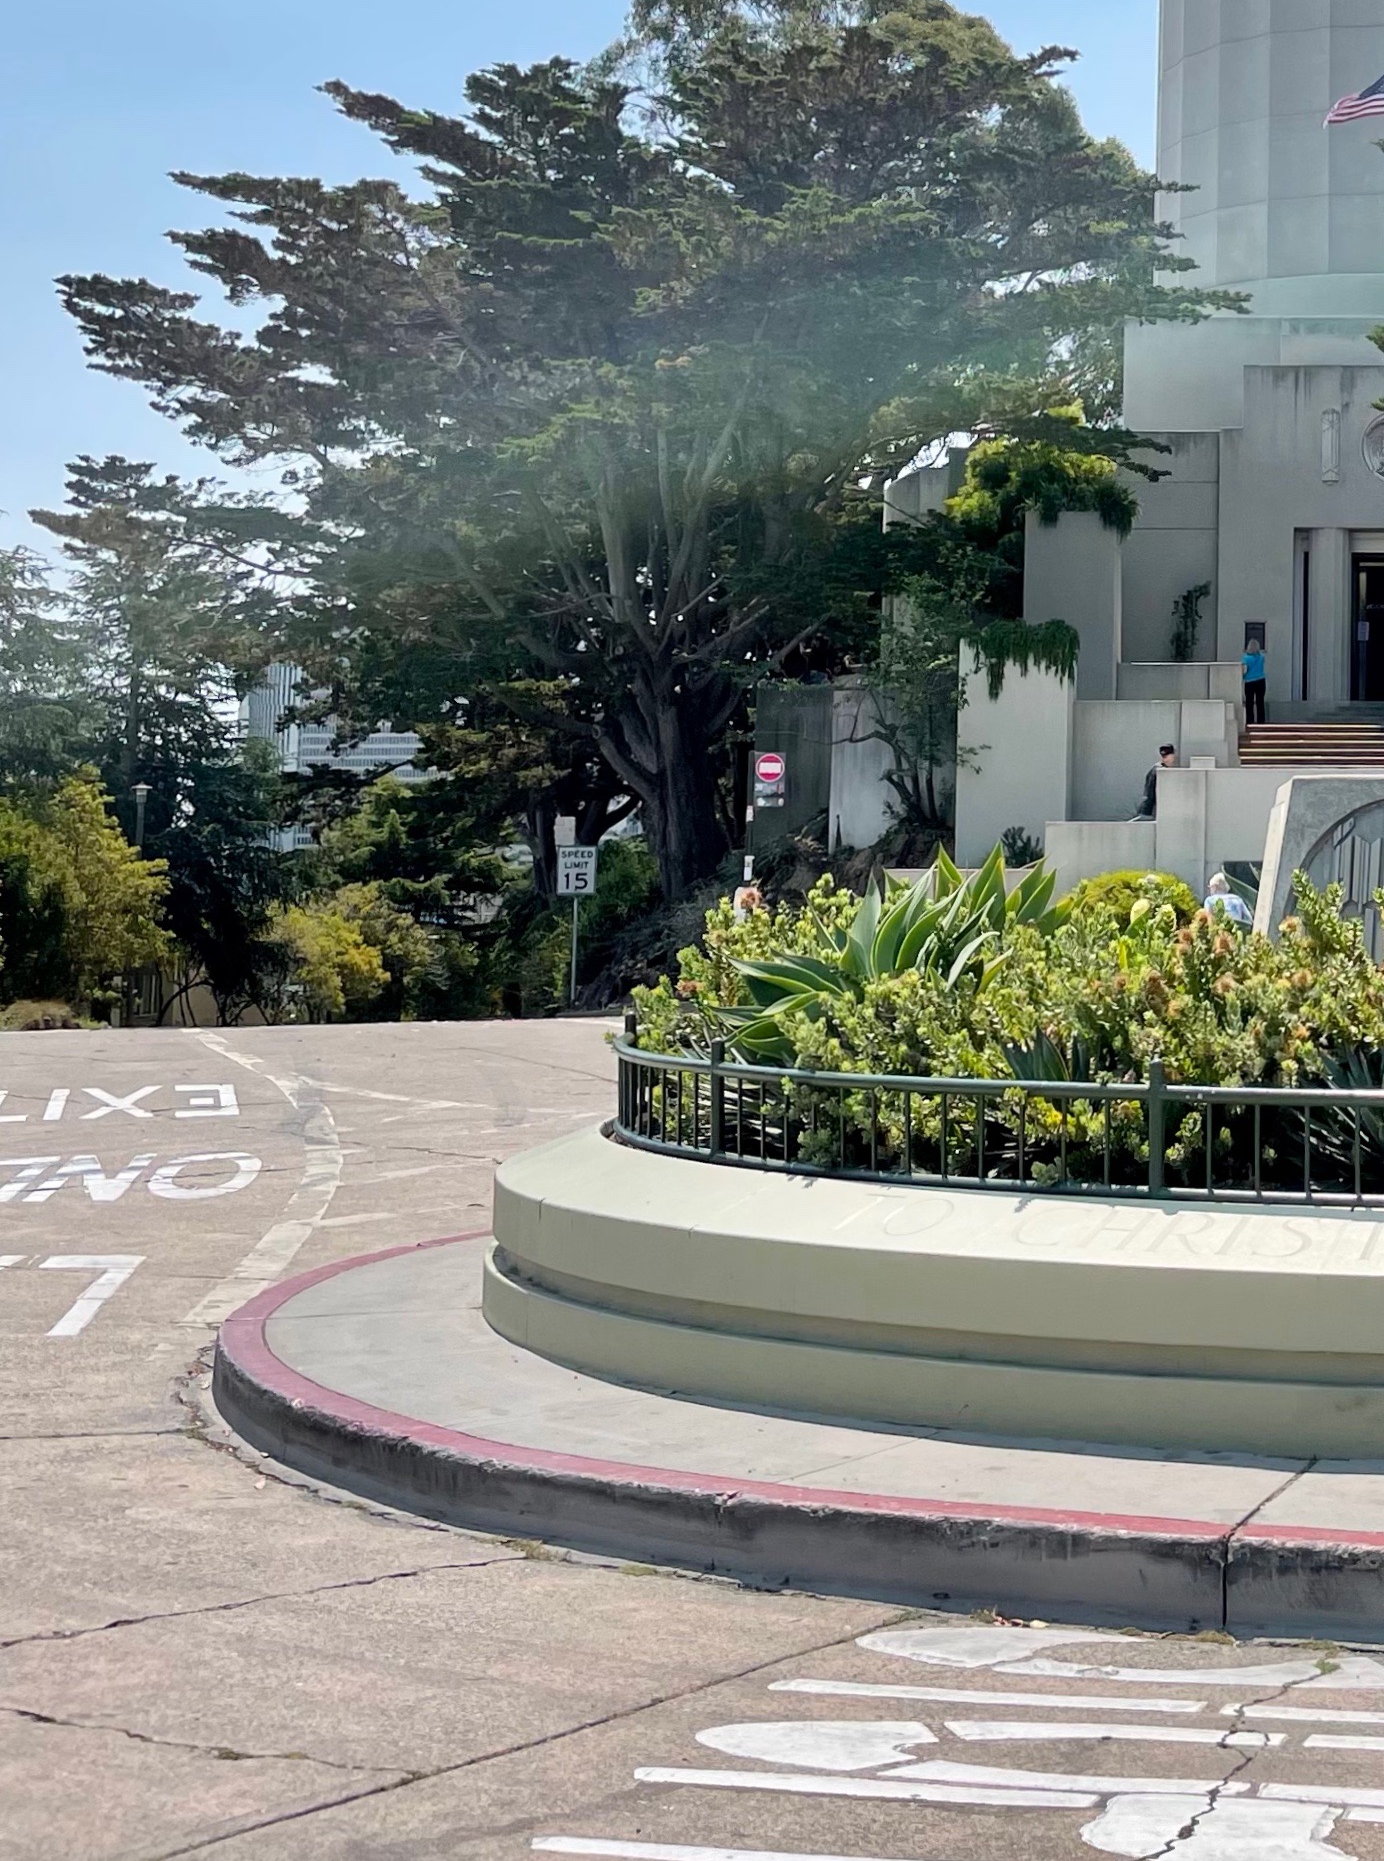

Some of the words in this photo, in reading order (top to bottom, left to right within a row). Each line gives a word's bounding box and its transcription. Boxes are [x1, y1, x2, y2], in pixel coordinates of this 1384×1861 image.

[561, 850, 594, 859] SPEED
[564, 861, 589, 869] LIMIT
[564, 873, 589, 892] 15
[0, 1151, 263, 1203] ONL
[834, 1192, 954, 1237] TO
